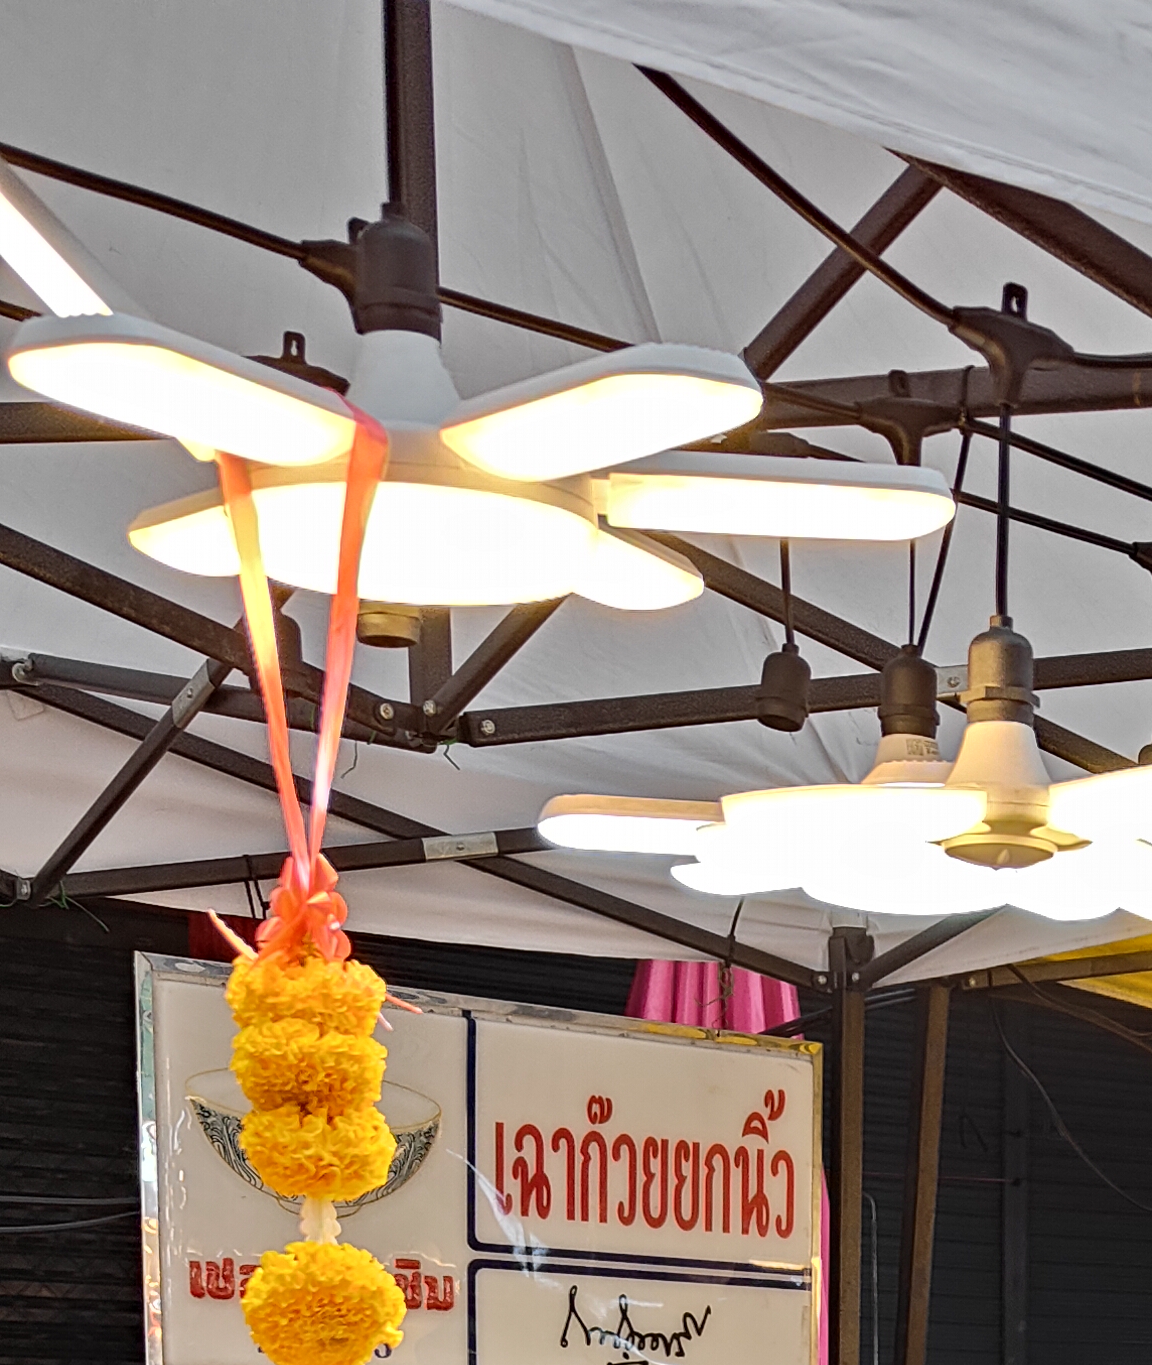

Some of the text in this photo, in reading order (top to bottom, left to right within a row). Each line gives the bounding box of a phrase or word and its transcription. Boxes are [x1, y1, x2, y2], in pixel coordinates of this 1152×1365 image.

[495, 1089, 795, 1239] เฉาก๊วยยกนิ้ว
